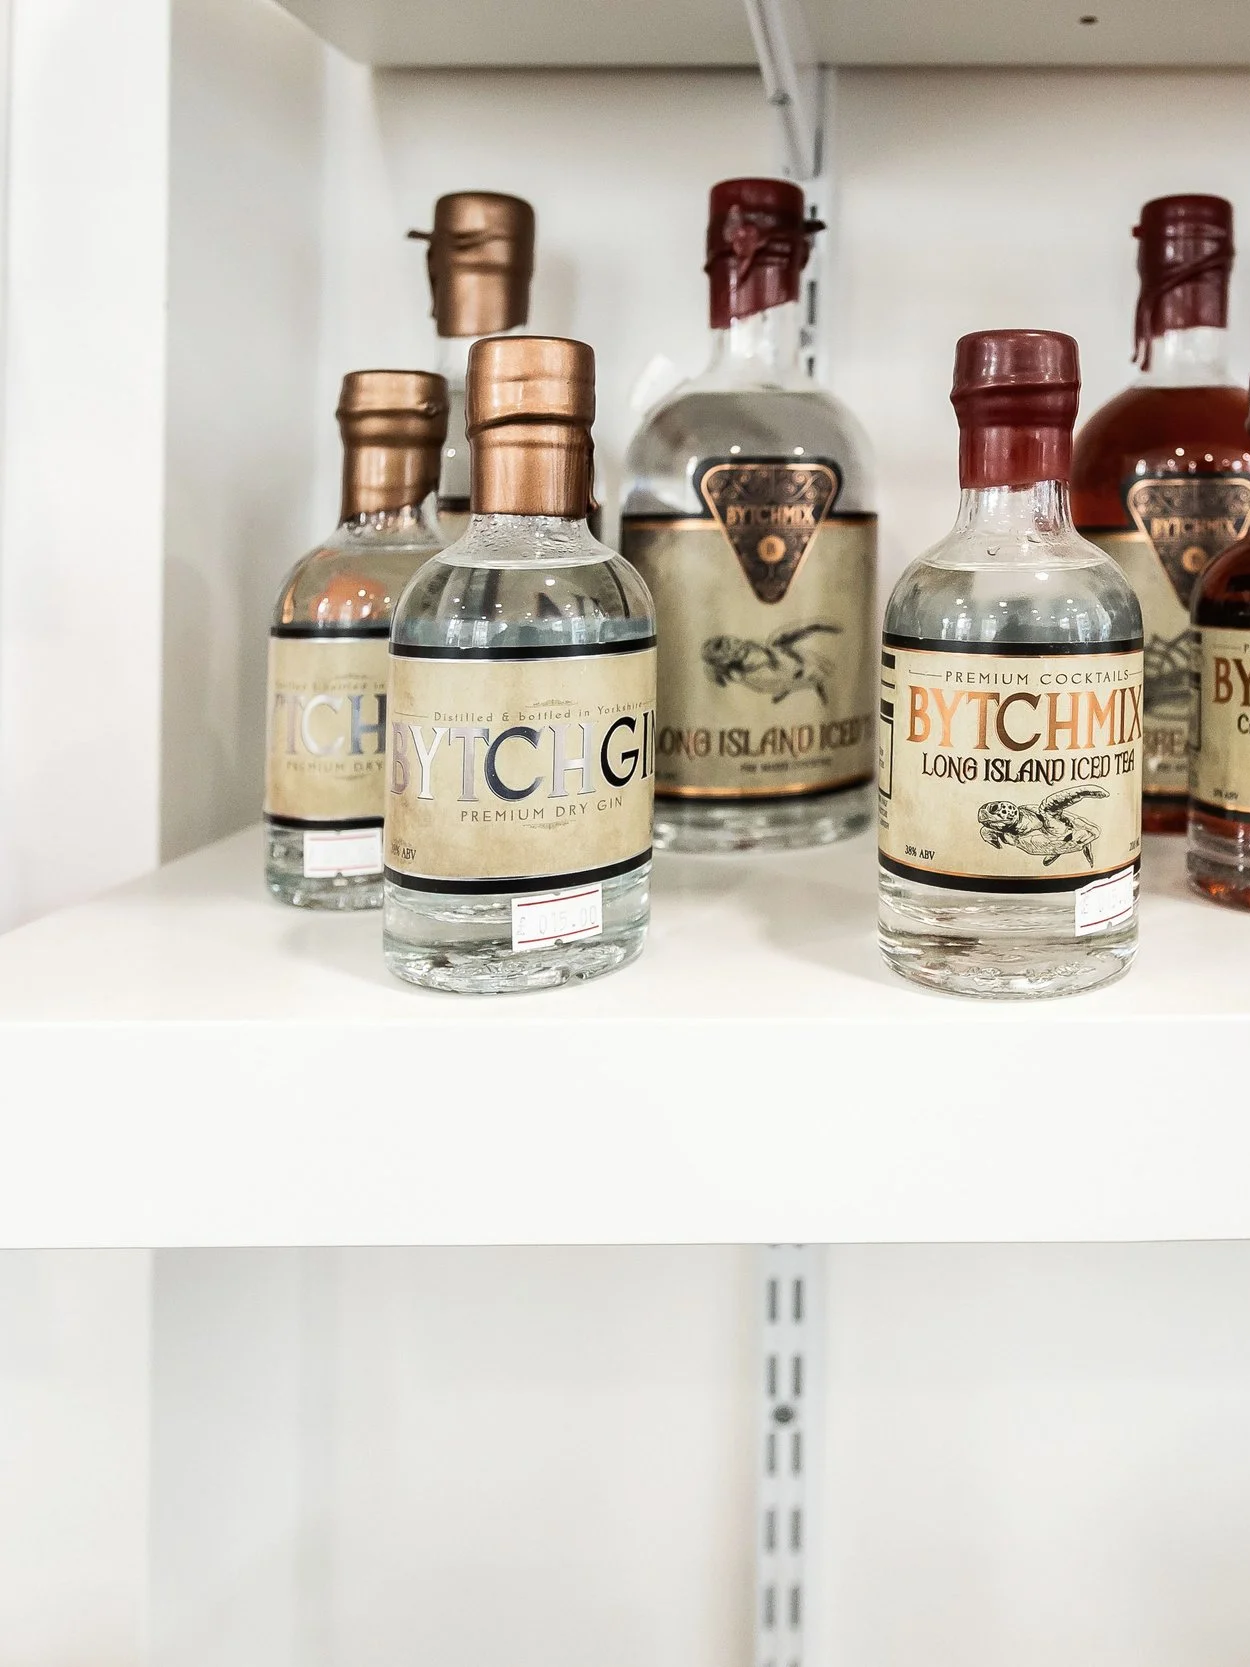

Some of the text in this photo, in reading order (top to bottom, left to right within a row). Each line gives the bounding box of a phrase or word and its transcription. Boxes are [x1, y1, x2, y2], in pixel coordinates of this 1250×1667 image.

[945, 670, 1130, 685] PREMIUM COCKTAILS
[434, 702, 643, 722] Distilled & bottled in Yorkshire
[905, 684, 1142, 752] BYTCHMIX
[658, 724, 712, 760] ONG
[718, 724, 815, 760] ISLAND
[921, 748, 1135, 786] LONG ISLAND ICED TEA
[461, 796, 623, 823] PREMIUM DRY GIN
[401, 847, 417, 860] ABV
[904, 844, 935, 861] 38% ABV
